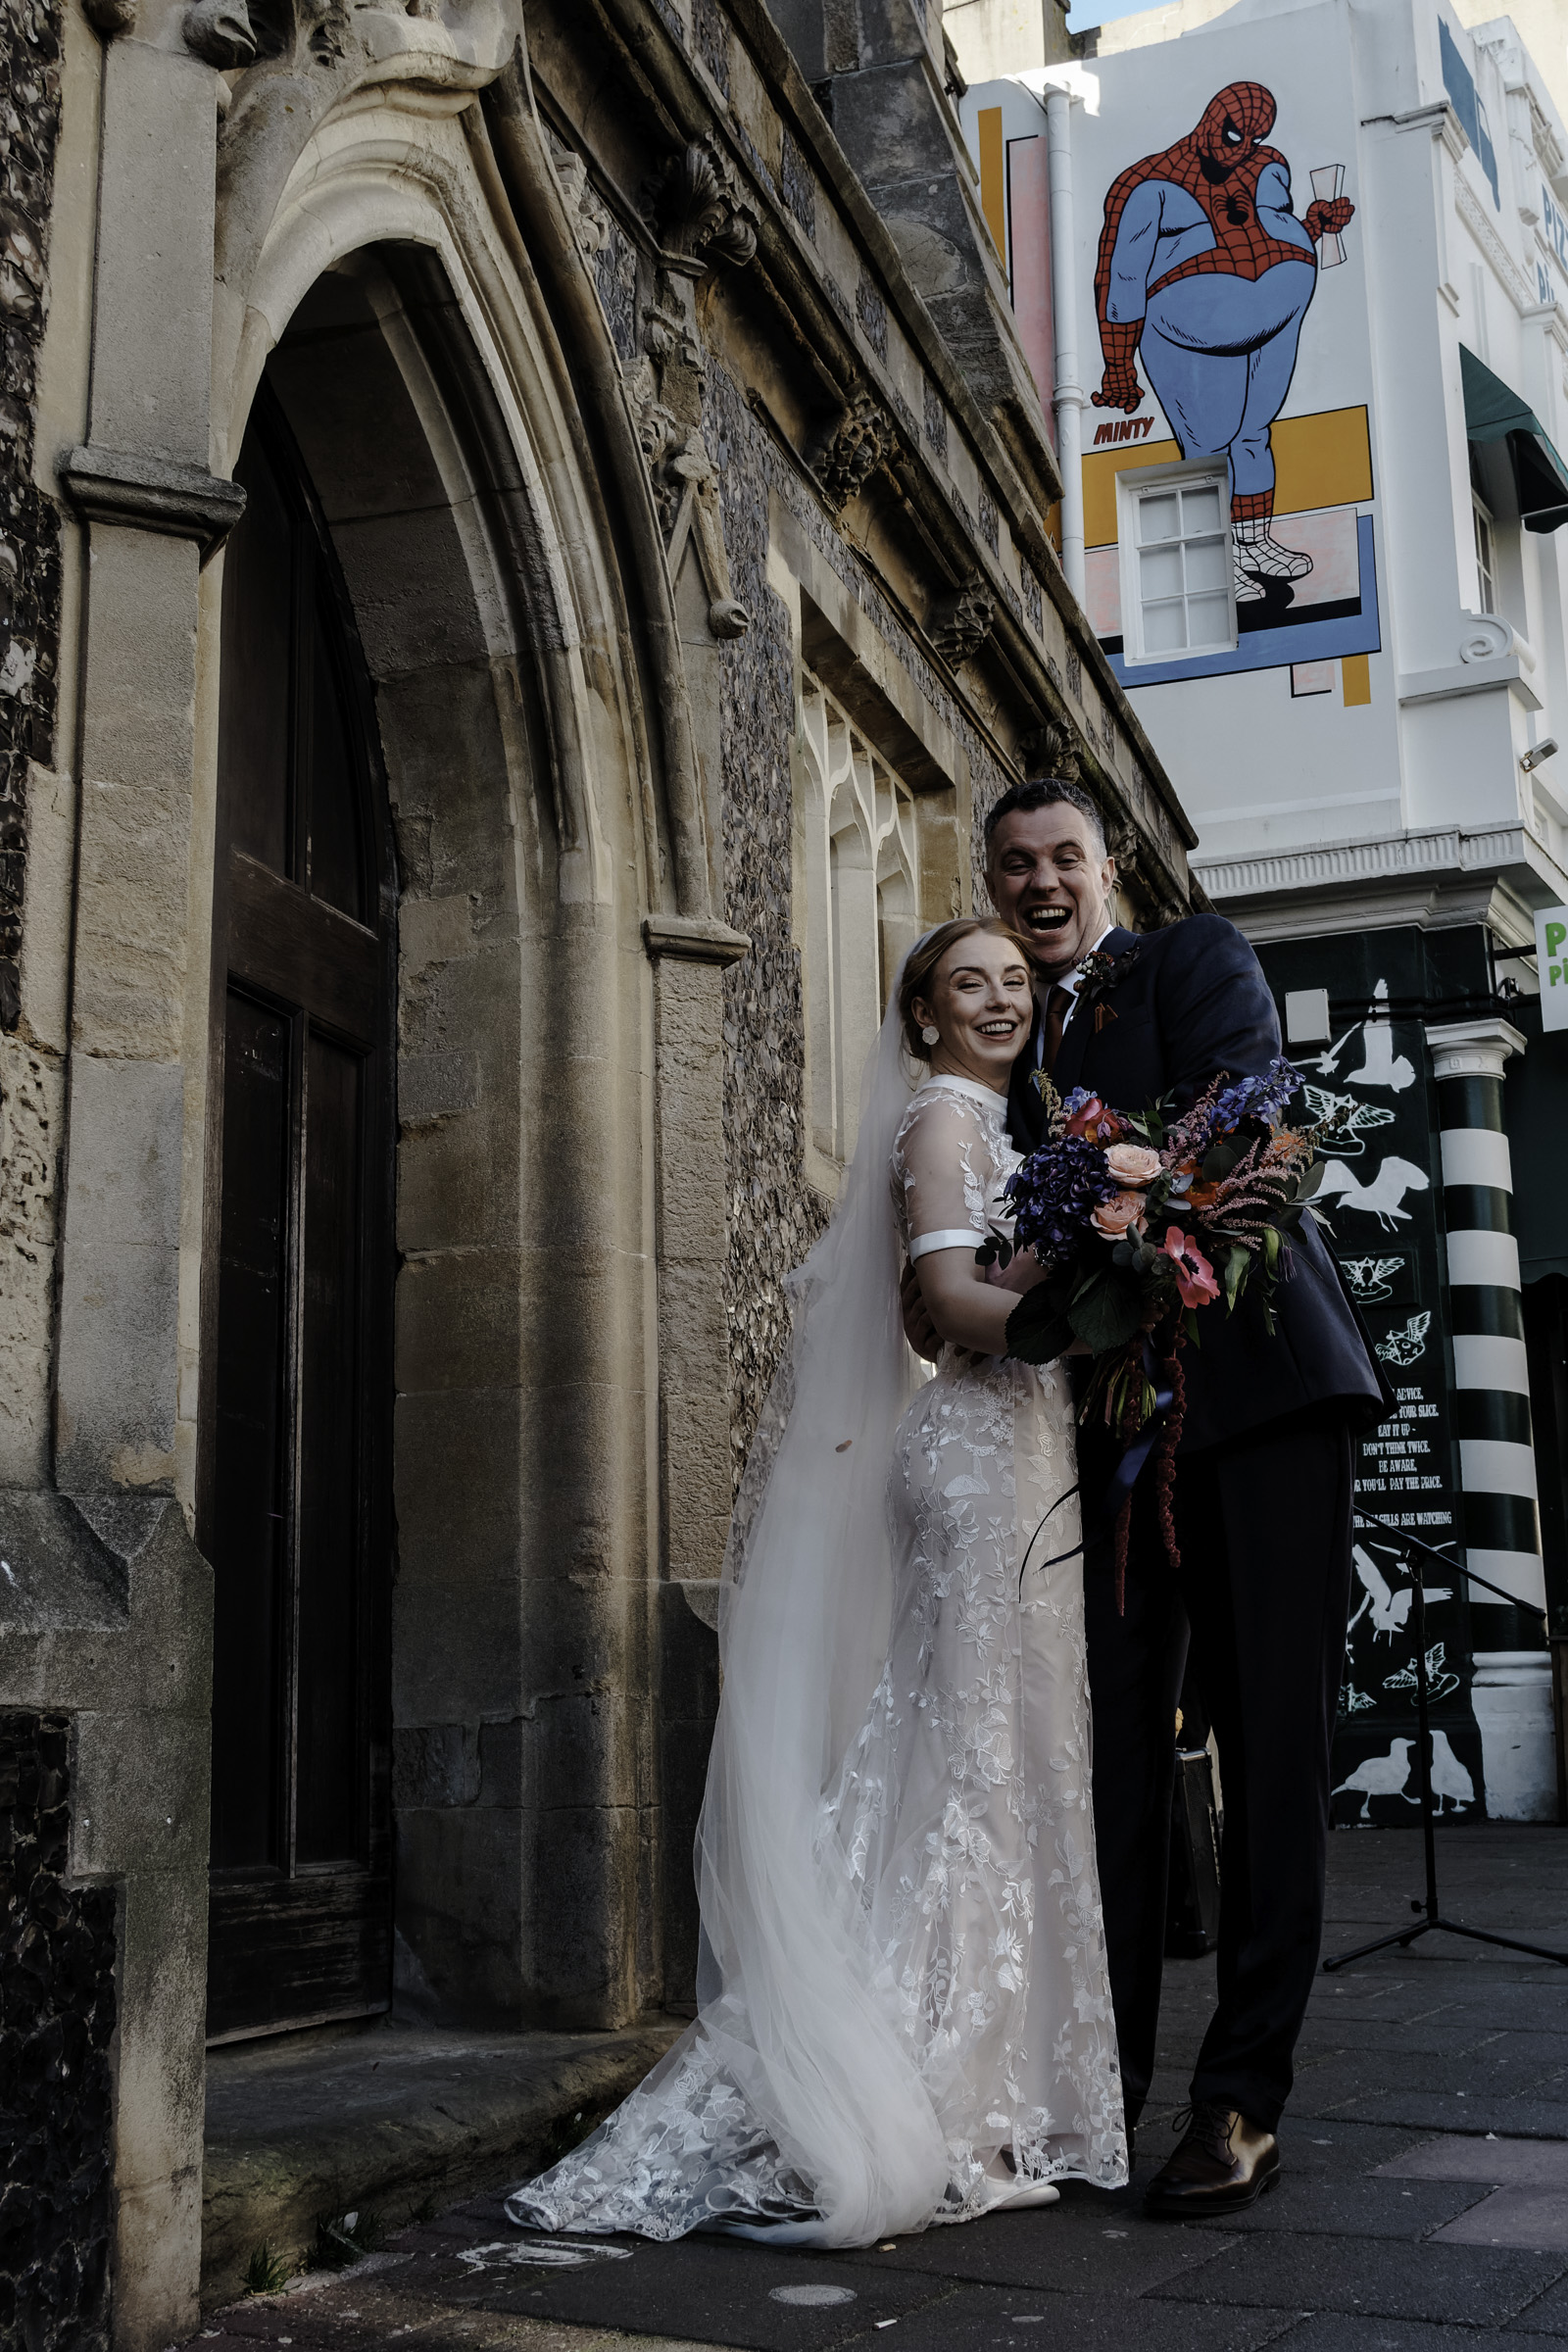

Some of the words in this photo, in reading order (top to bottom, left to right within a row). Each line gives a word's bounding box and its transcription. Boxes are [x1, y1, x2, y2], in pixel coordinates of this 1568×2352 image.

[1542, 182, 1568, 270] PIZ
[1093, 416, 1155, 445] MINTY
[1396, 1388, 1424, 1400] ADVICE,
[1398, 1405, 1417, 1419] YOUR
[1418, 1404, 1440, 1417] SLICE.
[1378, 1424, 1392, 1438] EAT
[1392, 1424, 1400, 1437] IT
[1400, 1423, 1411, 1436] UP
[1362, 1442, 1385, 1456] DON'T
[1385, 1441, 1406, 1454] THINK
[1407, 1440, 1431, 1453] TWICE.
[1378, 1460, 1389, 1473] BE
[1390, 1458, 1417, 1472] AWARE,
[1361, 1478, 1387, 1492] YOU'LL
[1390, 1477, 1404, 1491] PAY
[1404, 1476, 1420, 1490] THE
[1420, 1475, 1444, 1490] PRICE.
[1400, 1512, 1416, 1526] ARE
[1416, 1511, 1452, 1526] WATCHING
